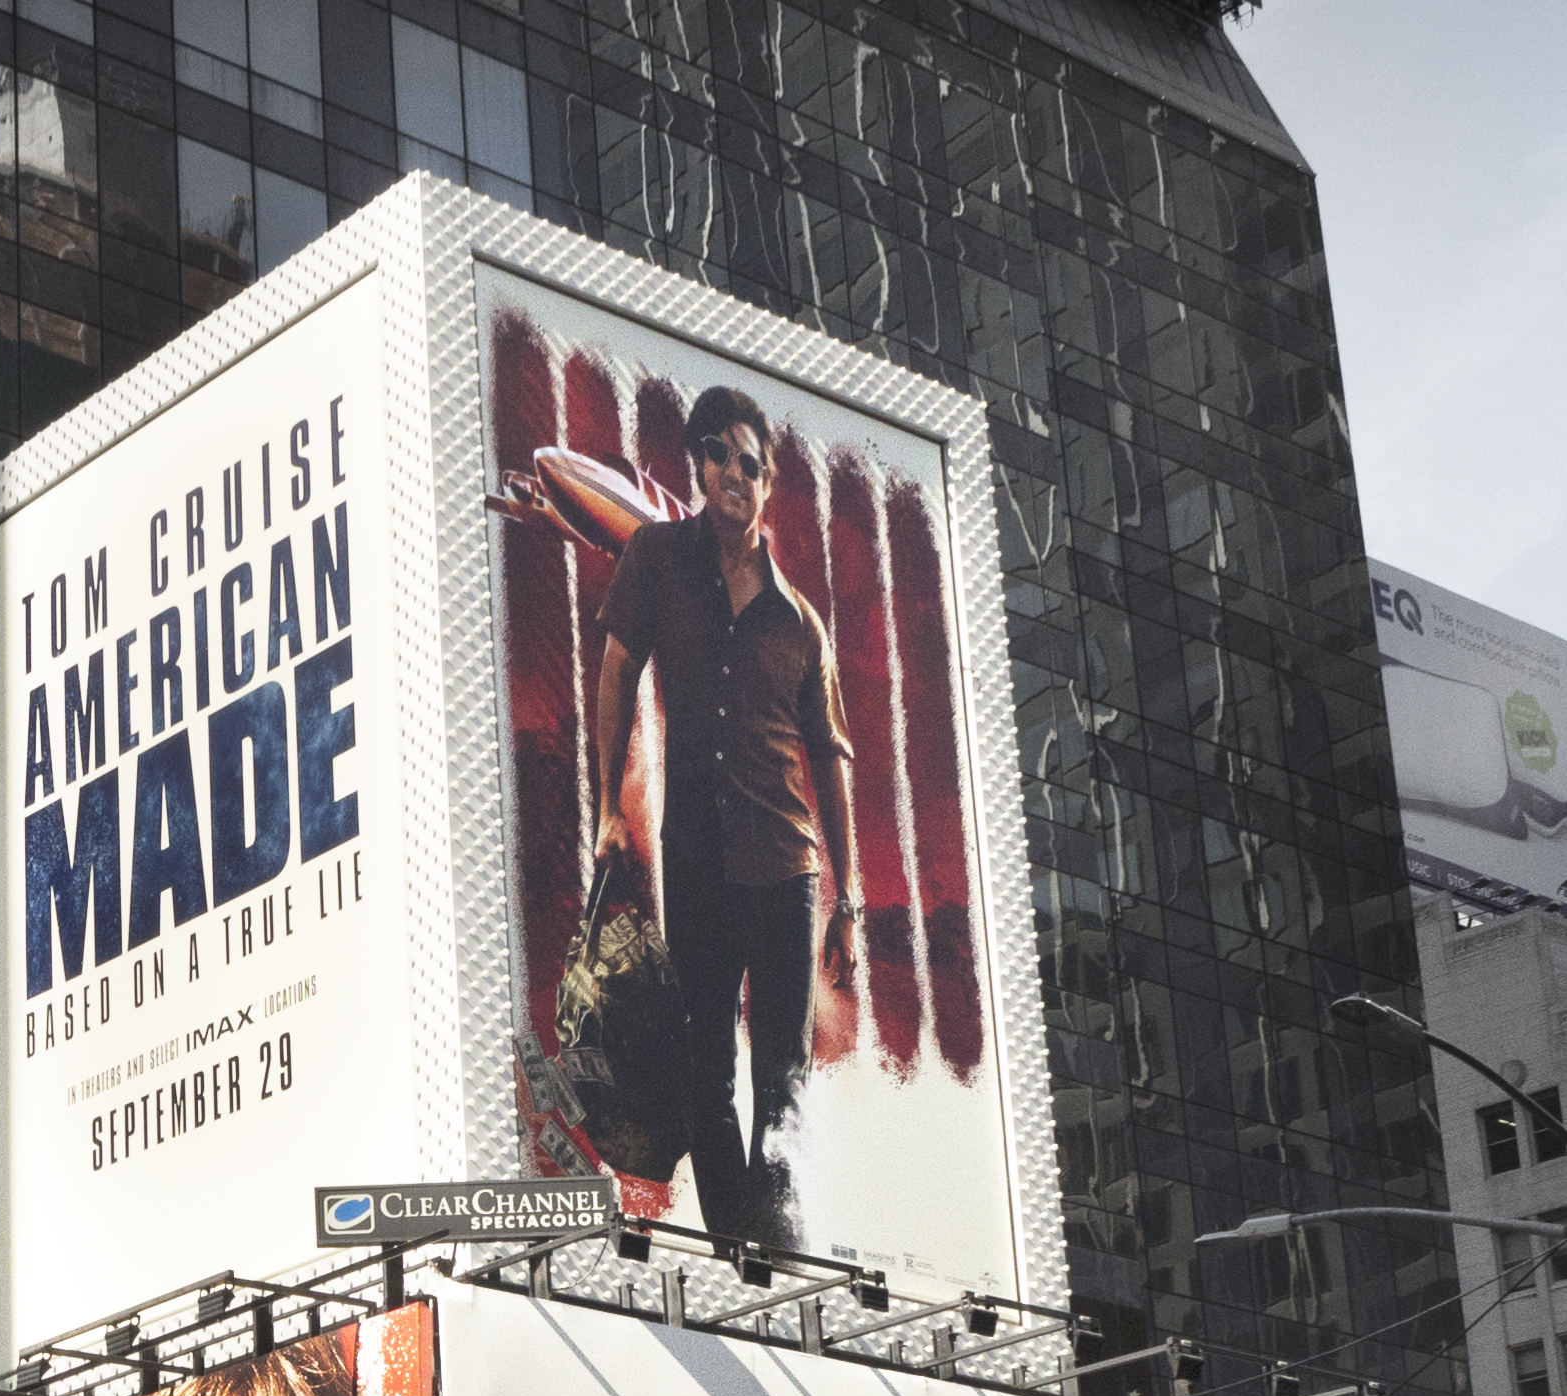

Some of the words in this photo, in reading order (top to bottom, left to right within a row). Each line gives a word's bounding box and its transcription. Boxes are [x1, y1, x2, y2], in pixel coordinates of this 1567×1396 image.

[21, 546, 108, 674] TOM
[150, 395, 346, 597] CRUISE
[24, 501, 352, 808] AMERICAN
[24, 635, 360, 1000] MADE
[25, 976, 111, 1058] BASED
[133, 949, 165, 1009] ON
[189, 933, 200, 983] A
[223, 885, 294, 966] TRUE
[318, 851, 362, 920] LIE
[67, 1086, 77, 1107] IN
[81, 1065, 122, 1102] THEATERS
[127, 1054, 144, 1080] AND
[150, 1037, 180, 1070] SELECT
[186, 1005, 254, 1053] IMAX
[264, 974, 317, 1018] LOCATIONS
[92, 1055, 242, 1172] SEPTEMBER
[259, 1032, 293, 1101] 29
[470, 1212, 605, 1230] SPECTACOLOR
